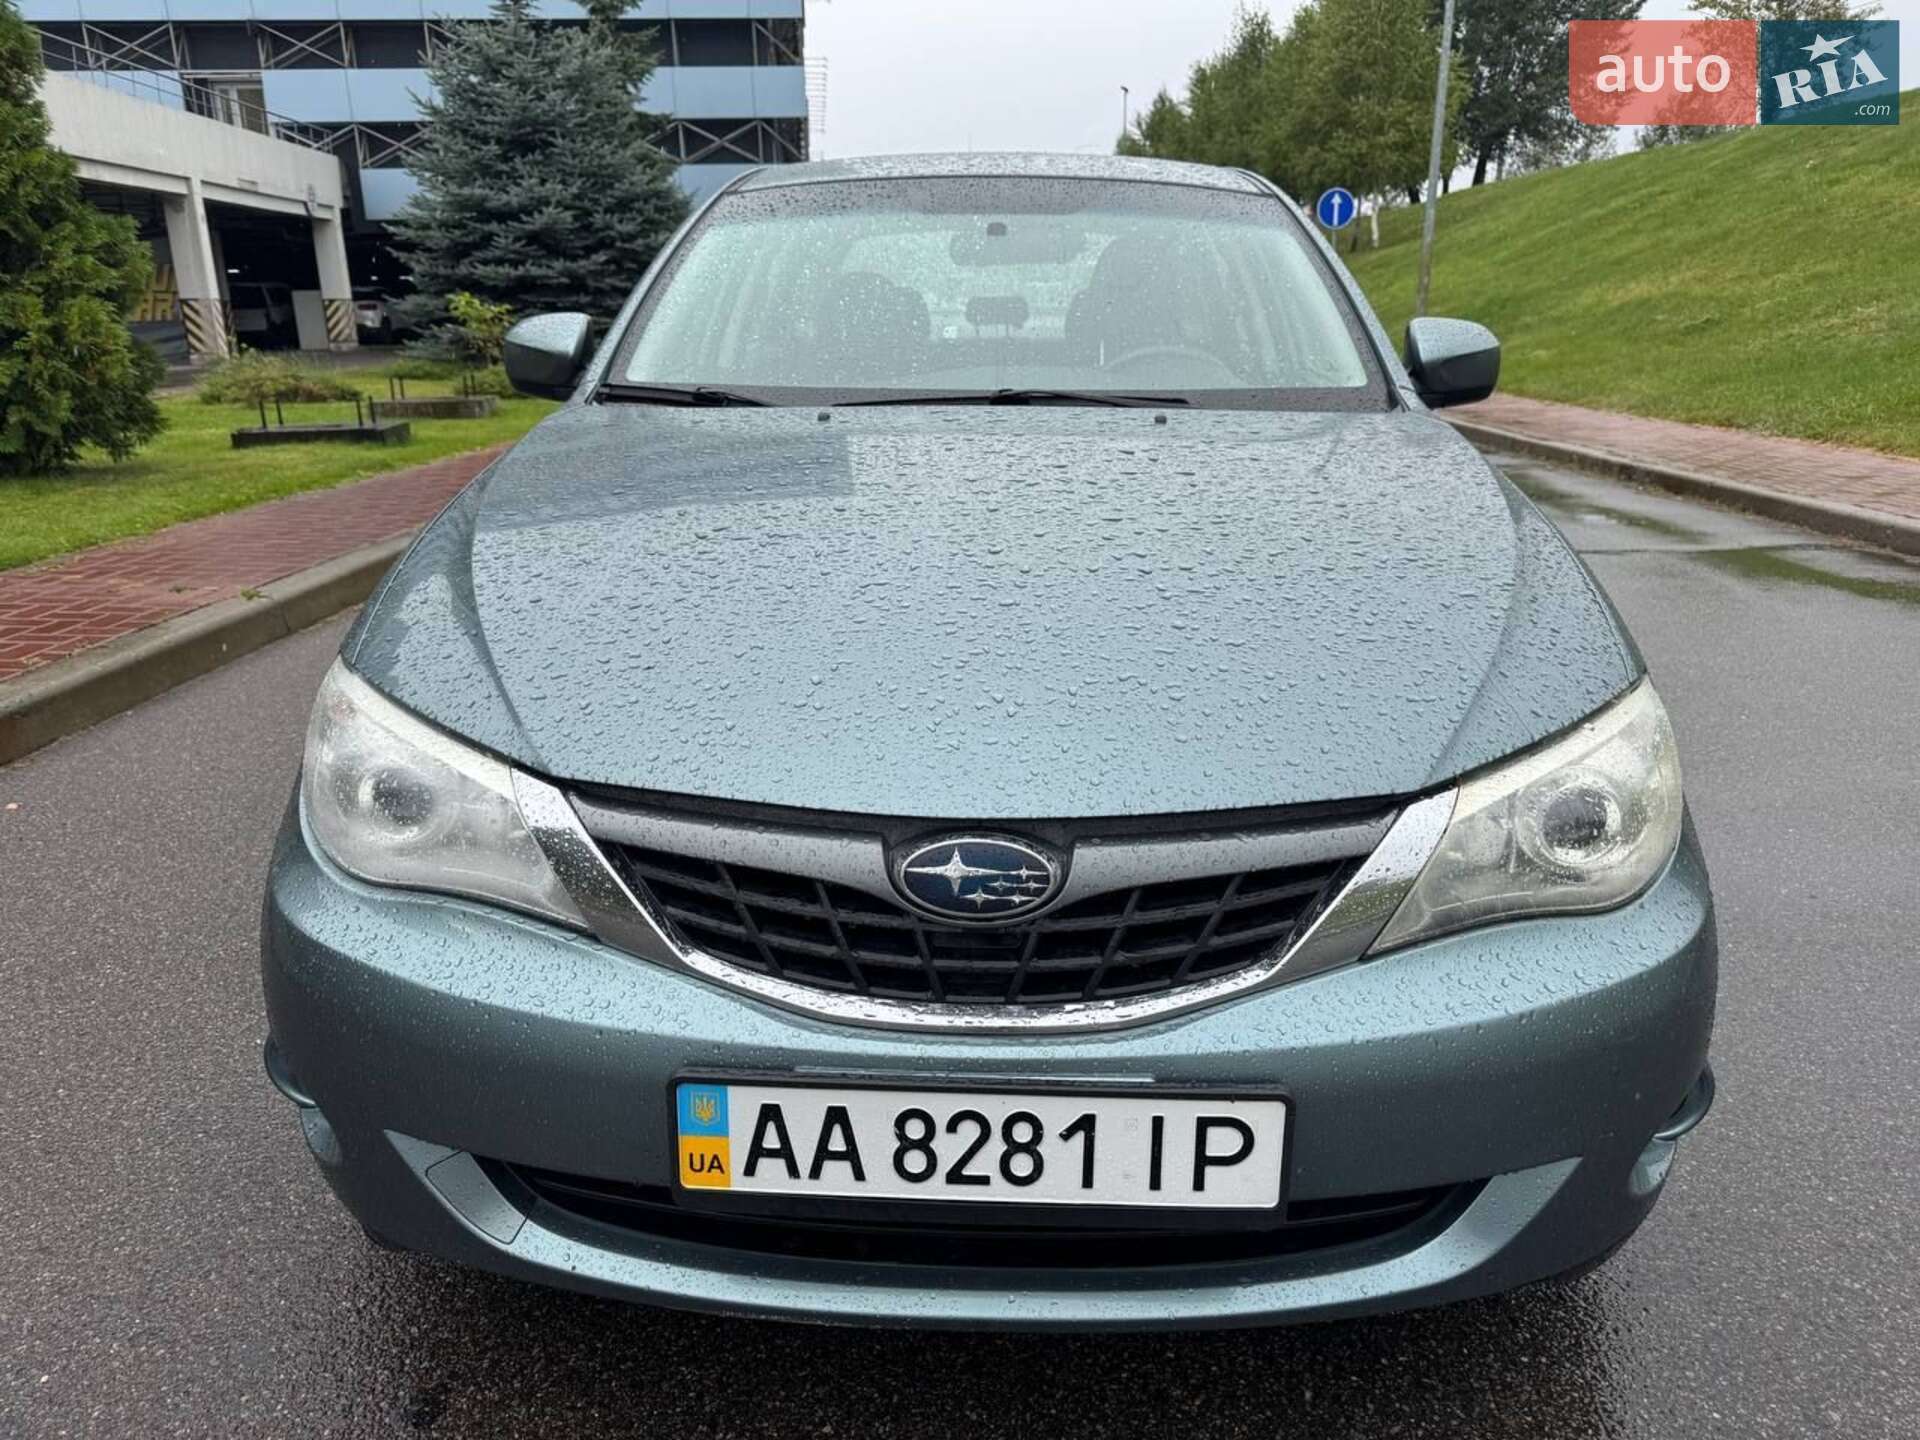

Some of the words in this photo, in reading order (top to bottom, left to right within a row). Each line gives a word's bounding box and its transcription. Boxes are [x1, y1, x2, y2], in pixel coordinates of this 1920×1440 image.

[688, 1152, 726, 1175] UA
[743, 1103, 866, 1182] AA
[892, 1108, 1097, 1189] 8281
[1149, 1115, 1255, 1192] IP
